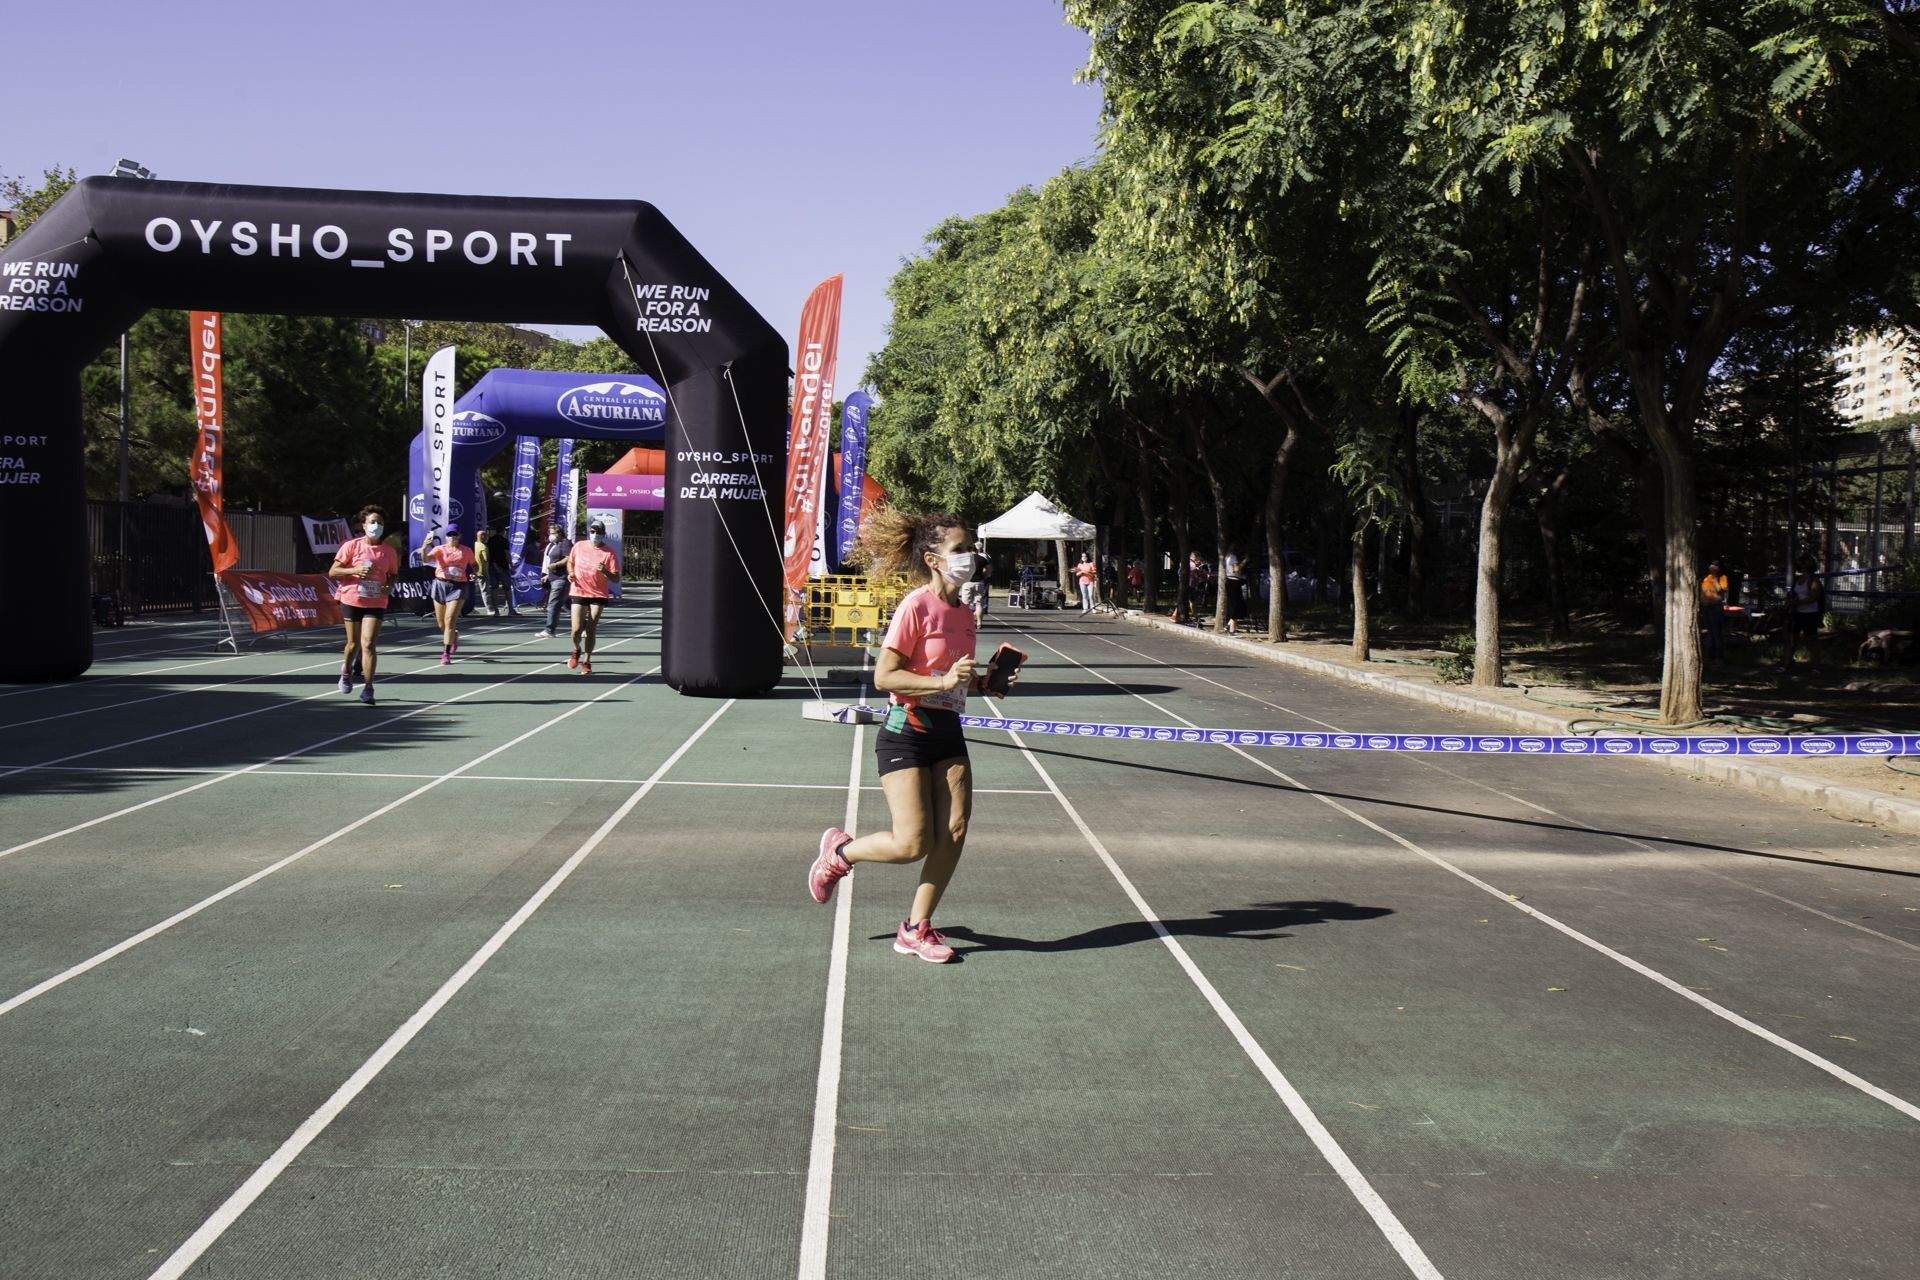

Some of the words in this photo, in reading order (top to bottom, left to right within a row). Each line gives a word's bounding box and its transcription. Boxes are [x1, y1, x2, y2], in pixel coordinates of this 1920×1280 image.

[145, 217, 573, 268] OYSHO_SPORT
[3, 261, 33, 276] WE
[35, 262, 79, 278] RUN
[8, 278, 50, 294] FOR
[53, 281, 68, 295] A
[636, 285, 668, 299] WE
[670, 285, 710, 301] RUN
[0, 295, 83, 312] REASON
[645, 301, 685, 316] FOR
[686, 302, 700, 316] A
[636, 317, 712, 333] REASON
[583, 396, 620, 404] CENTRAL
[452, 426, 500, 437] TURIANA
[788, 338, 823, 513] Santander
[0, 436, 48, 446] PORT
[677, 451, 774, 463] OYSHO_SPORT
[690, 472, 757, 485] CARRERA
[680, 487, 698, 499] DE
[700, 487, 717, 499] LA
[720, 488, 767, 500] MUJER
